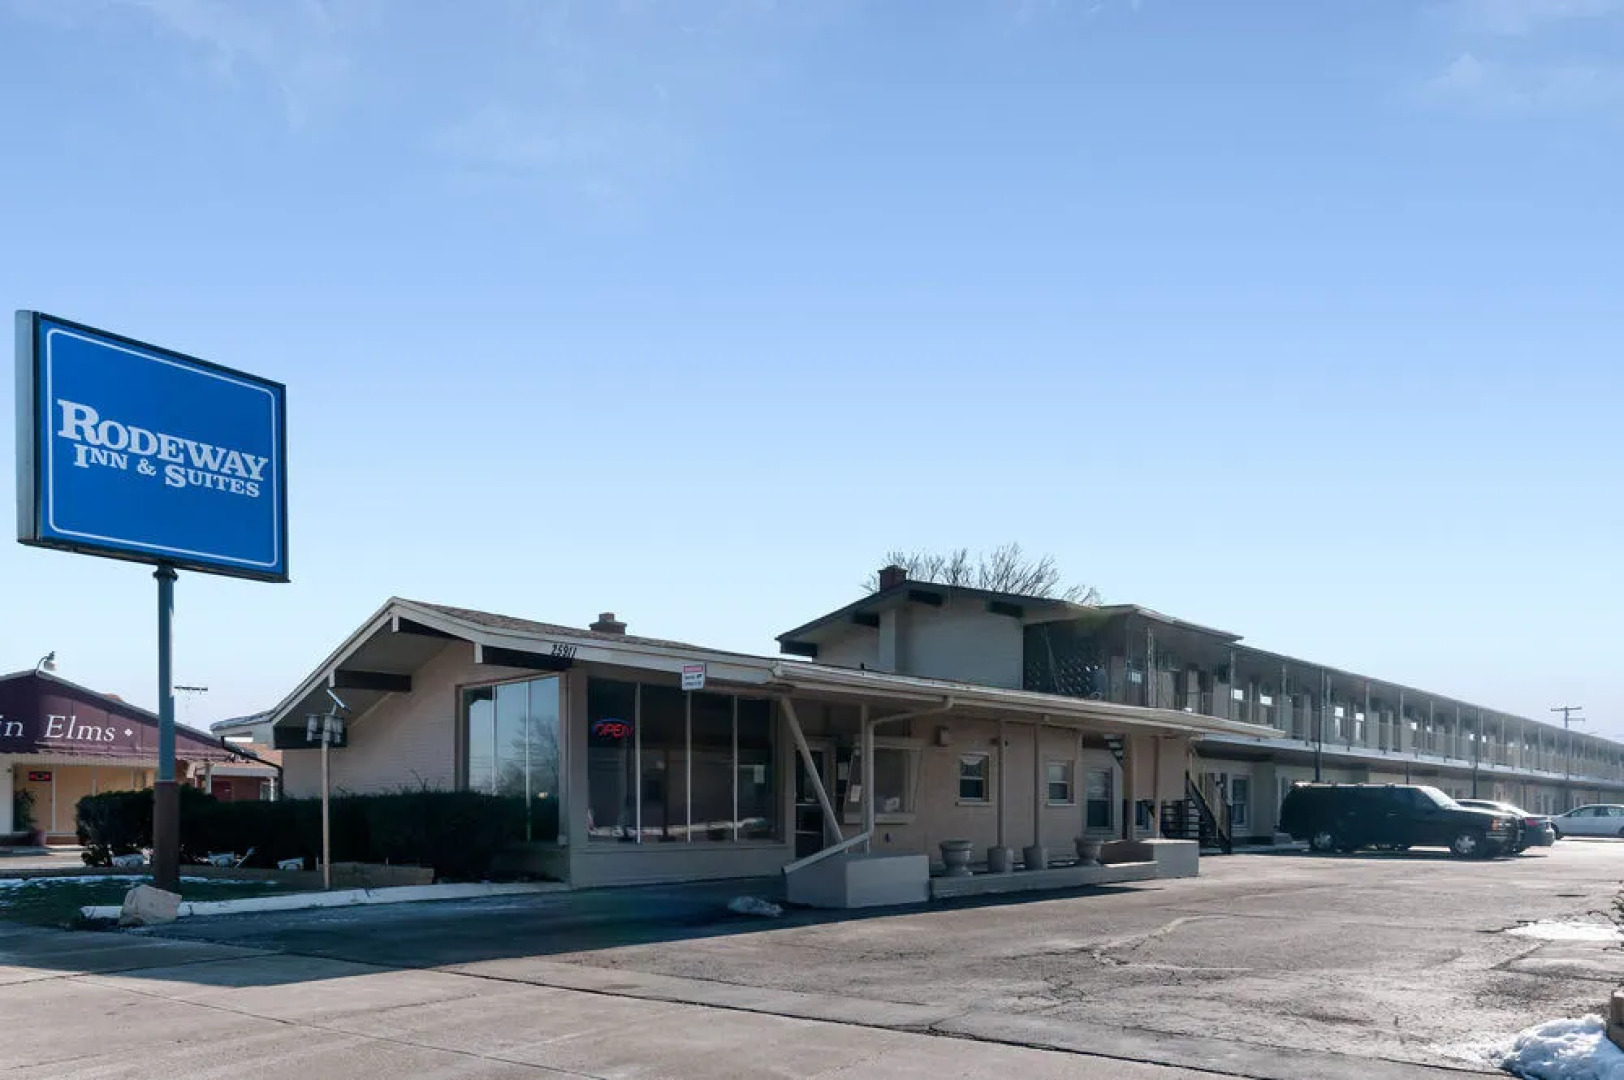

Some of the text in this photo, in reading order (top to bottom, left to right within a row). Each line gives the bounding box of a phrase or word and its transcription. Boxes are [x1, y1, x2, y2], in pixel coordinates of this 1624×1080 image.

[57, 399, 268, 481] RODEWAY
[74, 443, 260, 498] INN & SUITES
[0, 714, 116, 742] n Elms
[595, 724, 633, 738] OPEN
